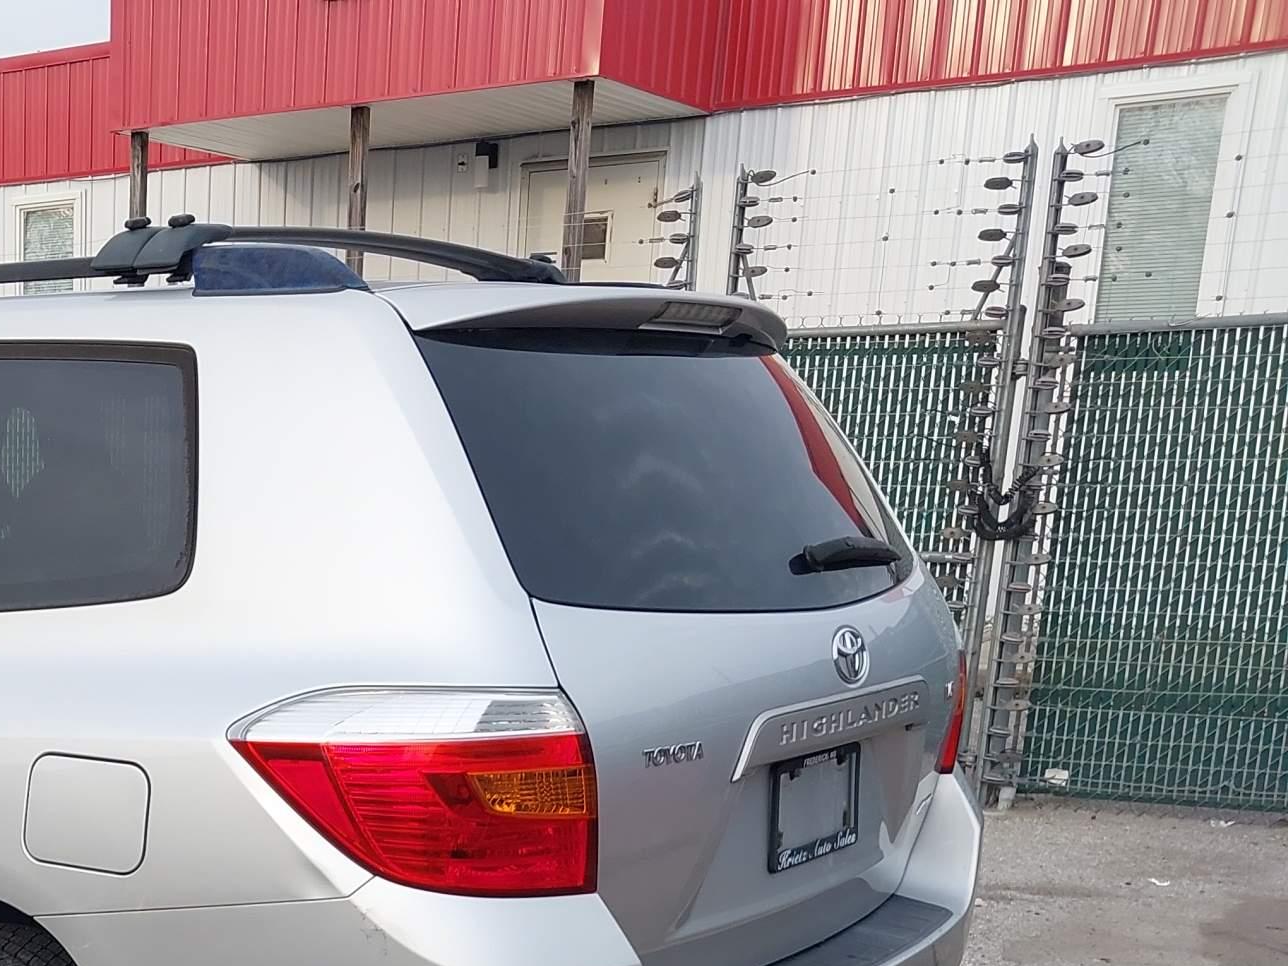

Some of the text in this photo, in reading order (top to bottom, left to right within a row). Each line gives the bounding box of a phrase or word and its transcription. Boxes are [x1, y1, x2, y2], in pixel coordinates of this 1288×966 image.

[778, 691, 920, 745] HIGHLANDER
[643, 740, 705, 768] TOYOTA
[808, 839, 832, 859] Auto
[834, 828, 856, 850] Sales
